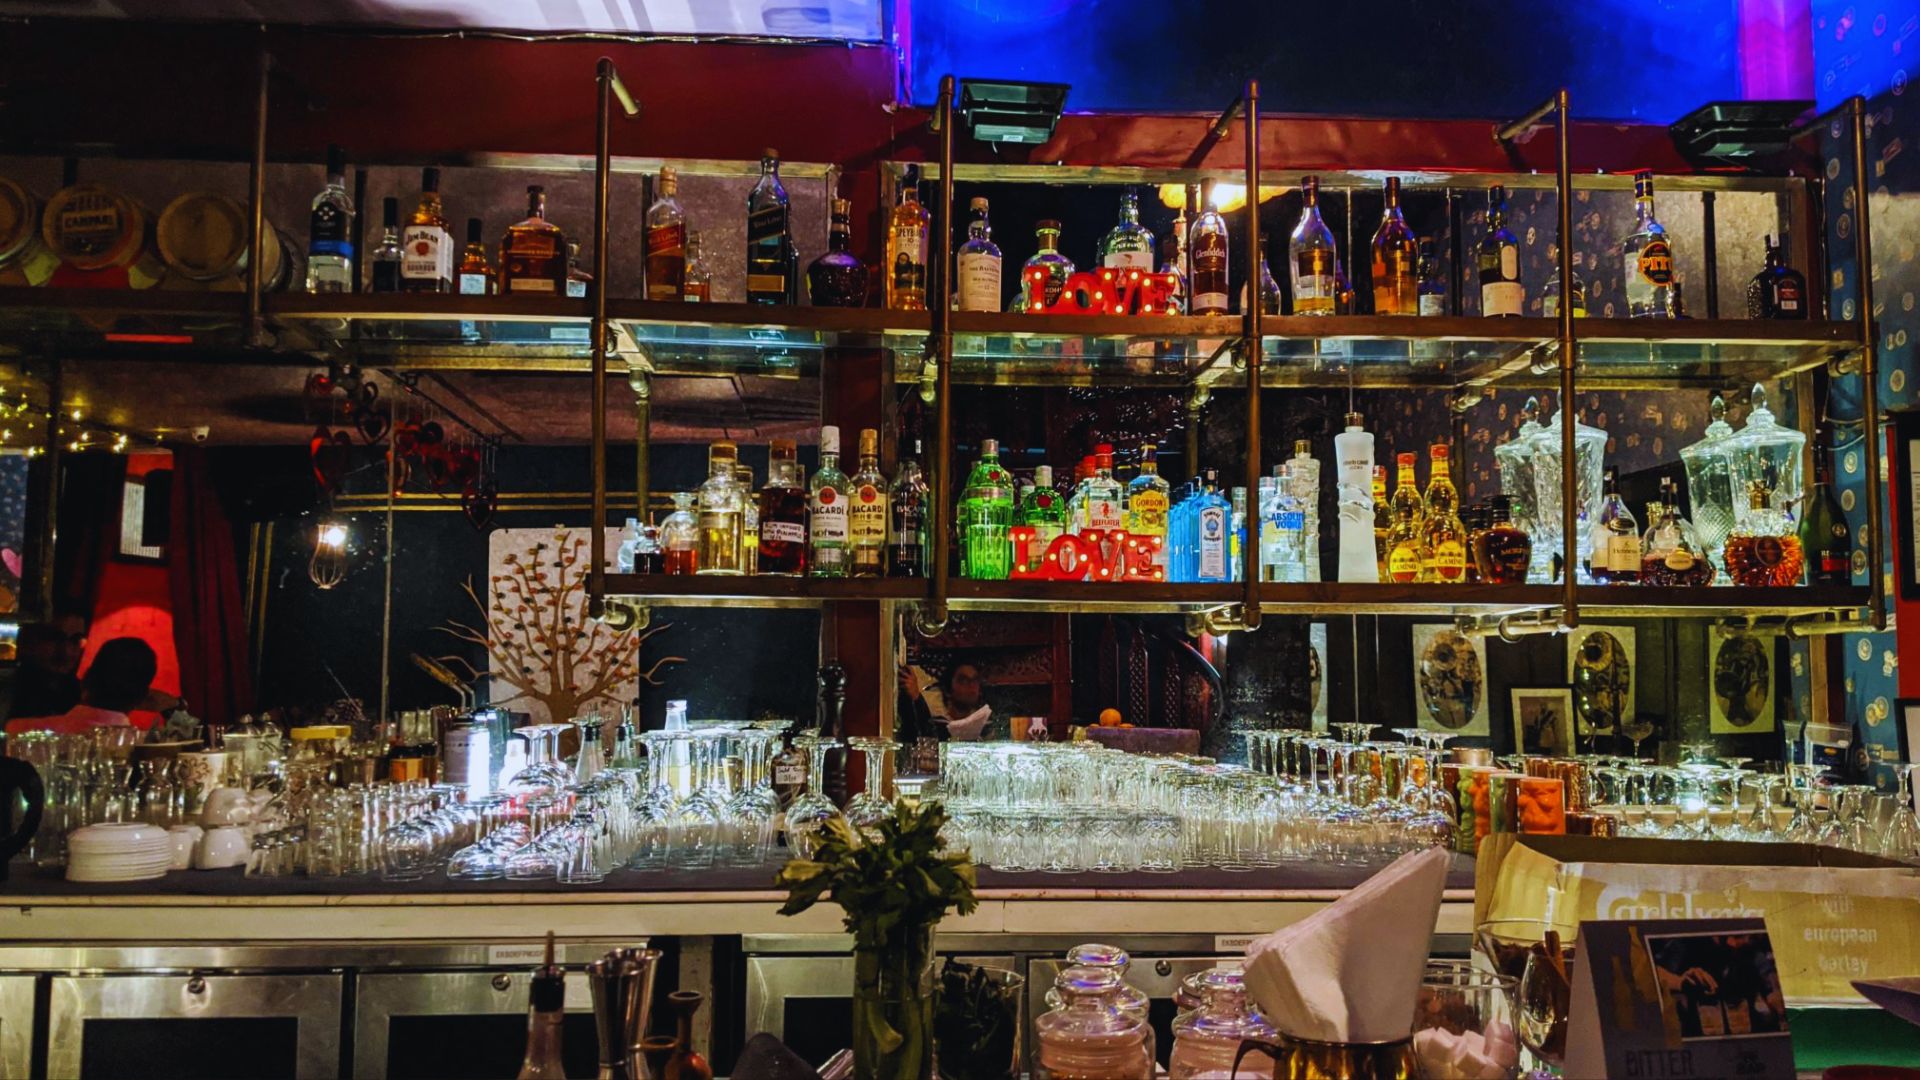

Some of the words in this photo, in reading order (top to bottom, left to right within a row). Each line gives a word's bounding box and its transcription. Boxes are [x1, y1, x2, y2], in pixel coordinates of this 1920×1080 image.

[1023, 265, 1179, 315] LOVE
[1008, 525, 1164, 582] LOVE
[1803, 926, 1878, 944] european
[1625, 1051, 1693, 1077] BITTER
